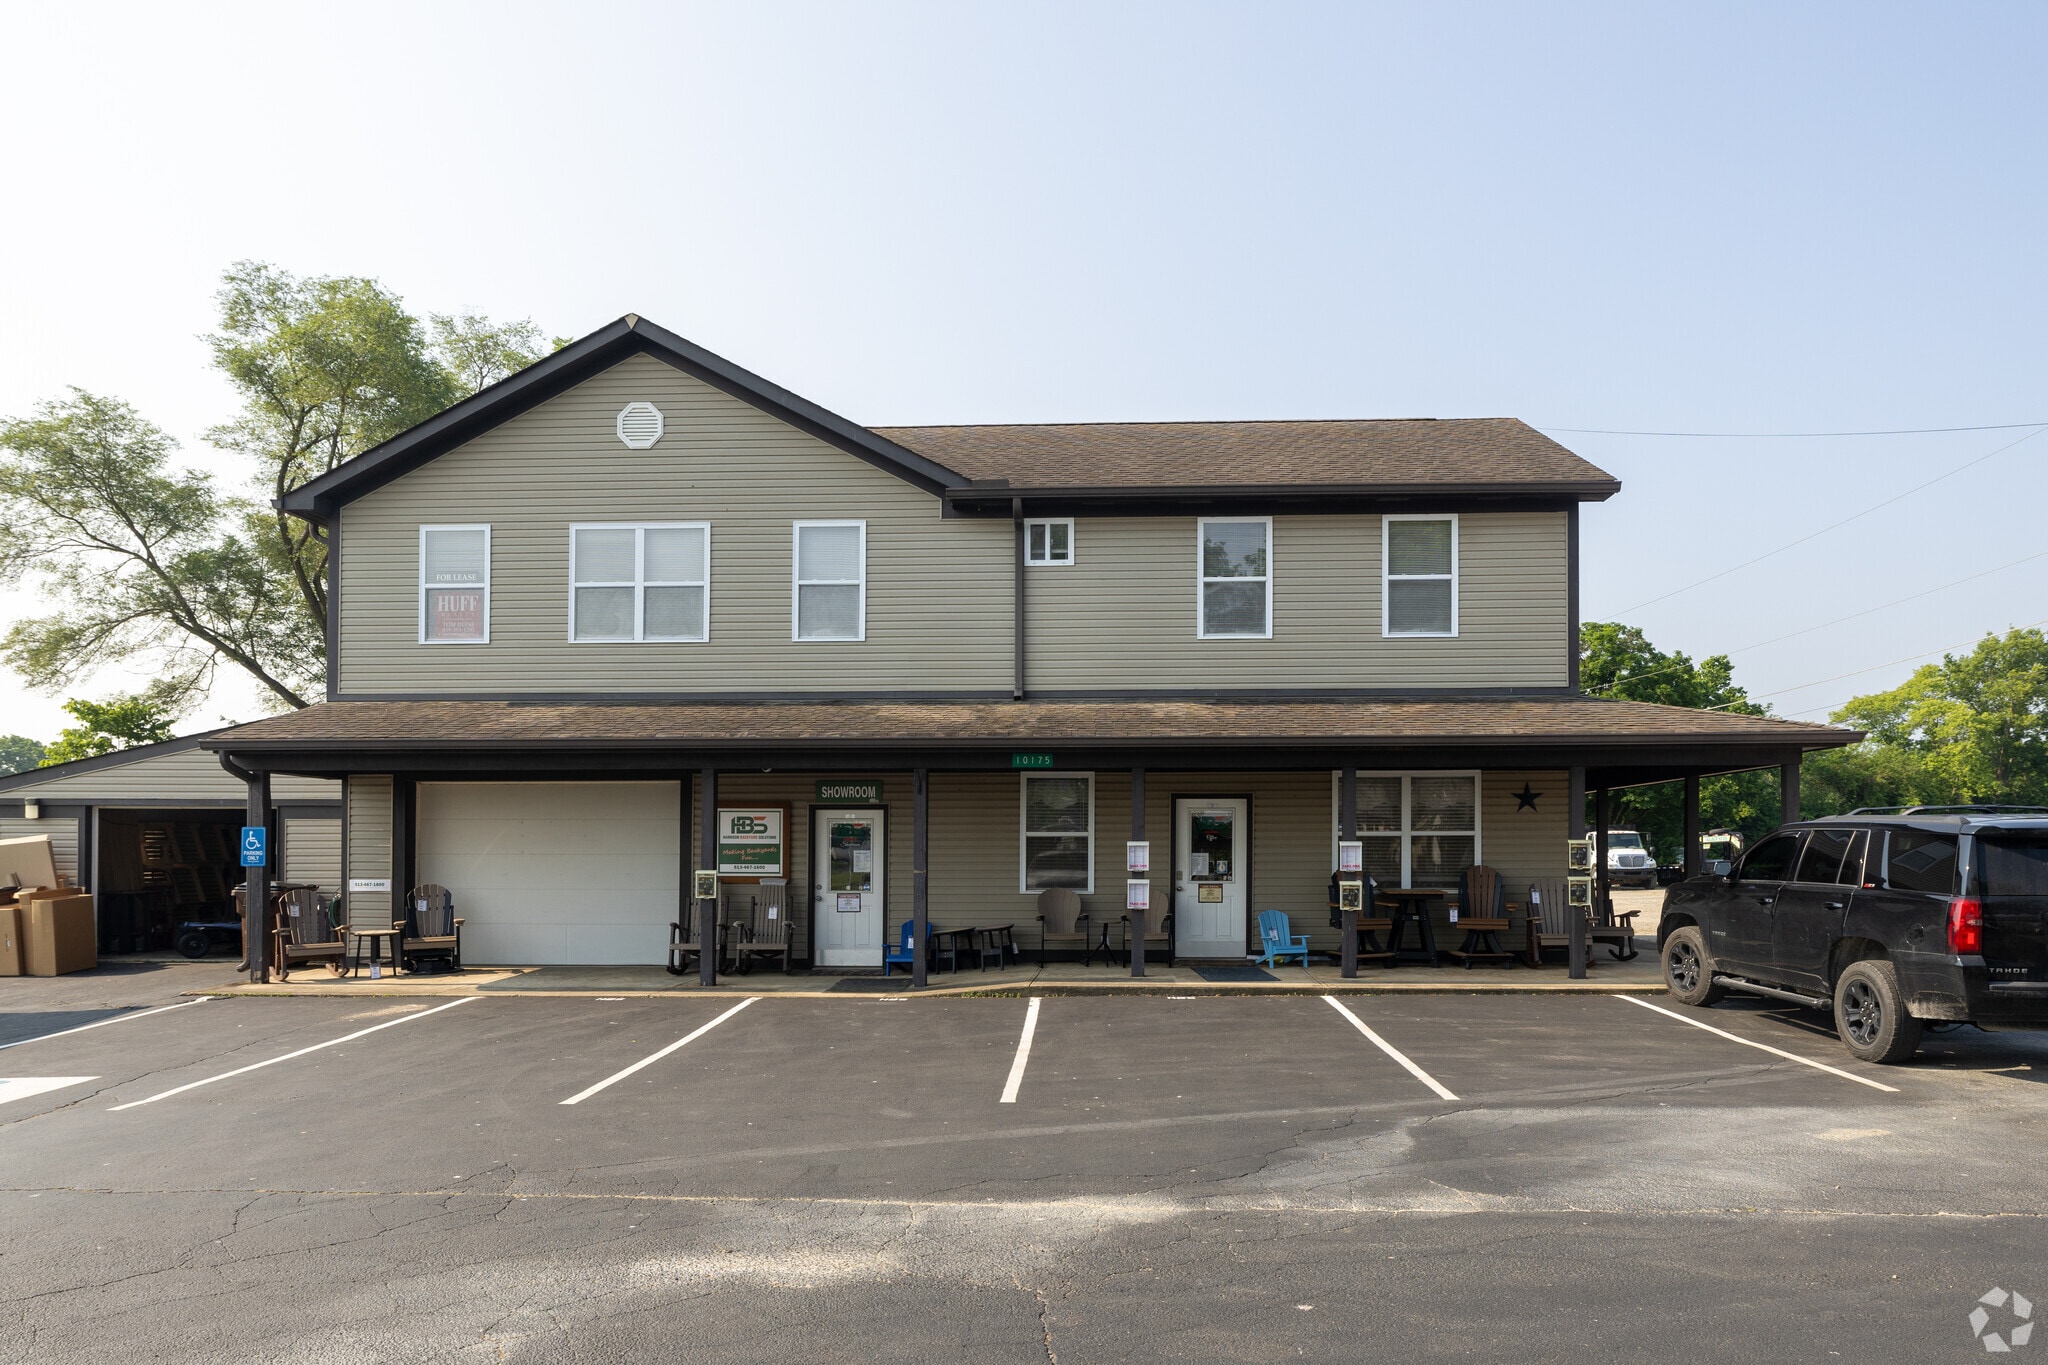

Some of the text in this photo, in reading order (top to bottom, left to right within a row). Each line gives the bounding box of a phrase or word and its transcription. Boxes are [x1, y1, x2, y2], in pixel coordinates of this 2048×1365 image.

[438, 595, 479, 612] HUFF
[1016, 756, 1050, 765] 10175
[821, 786, 876, 798] SHOWROOM
[731, 816, 768, 834] HBS
[746, 846, 777, 854] Backyards
